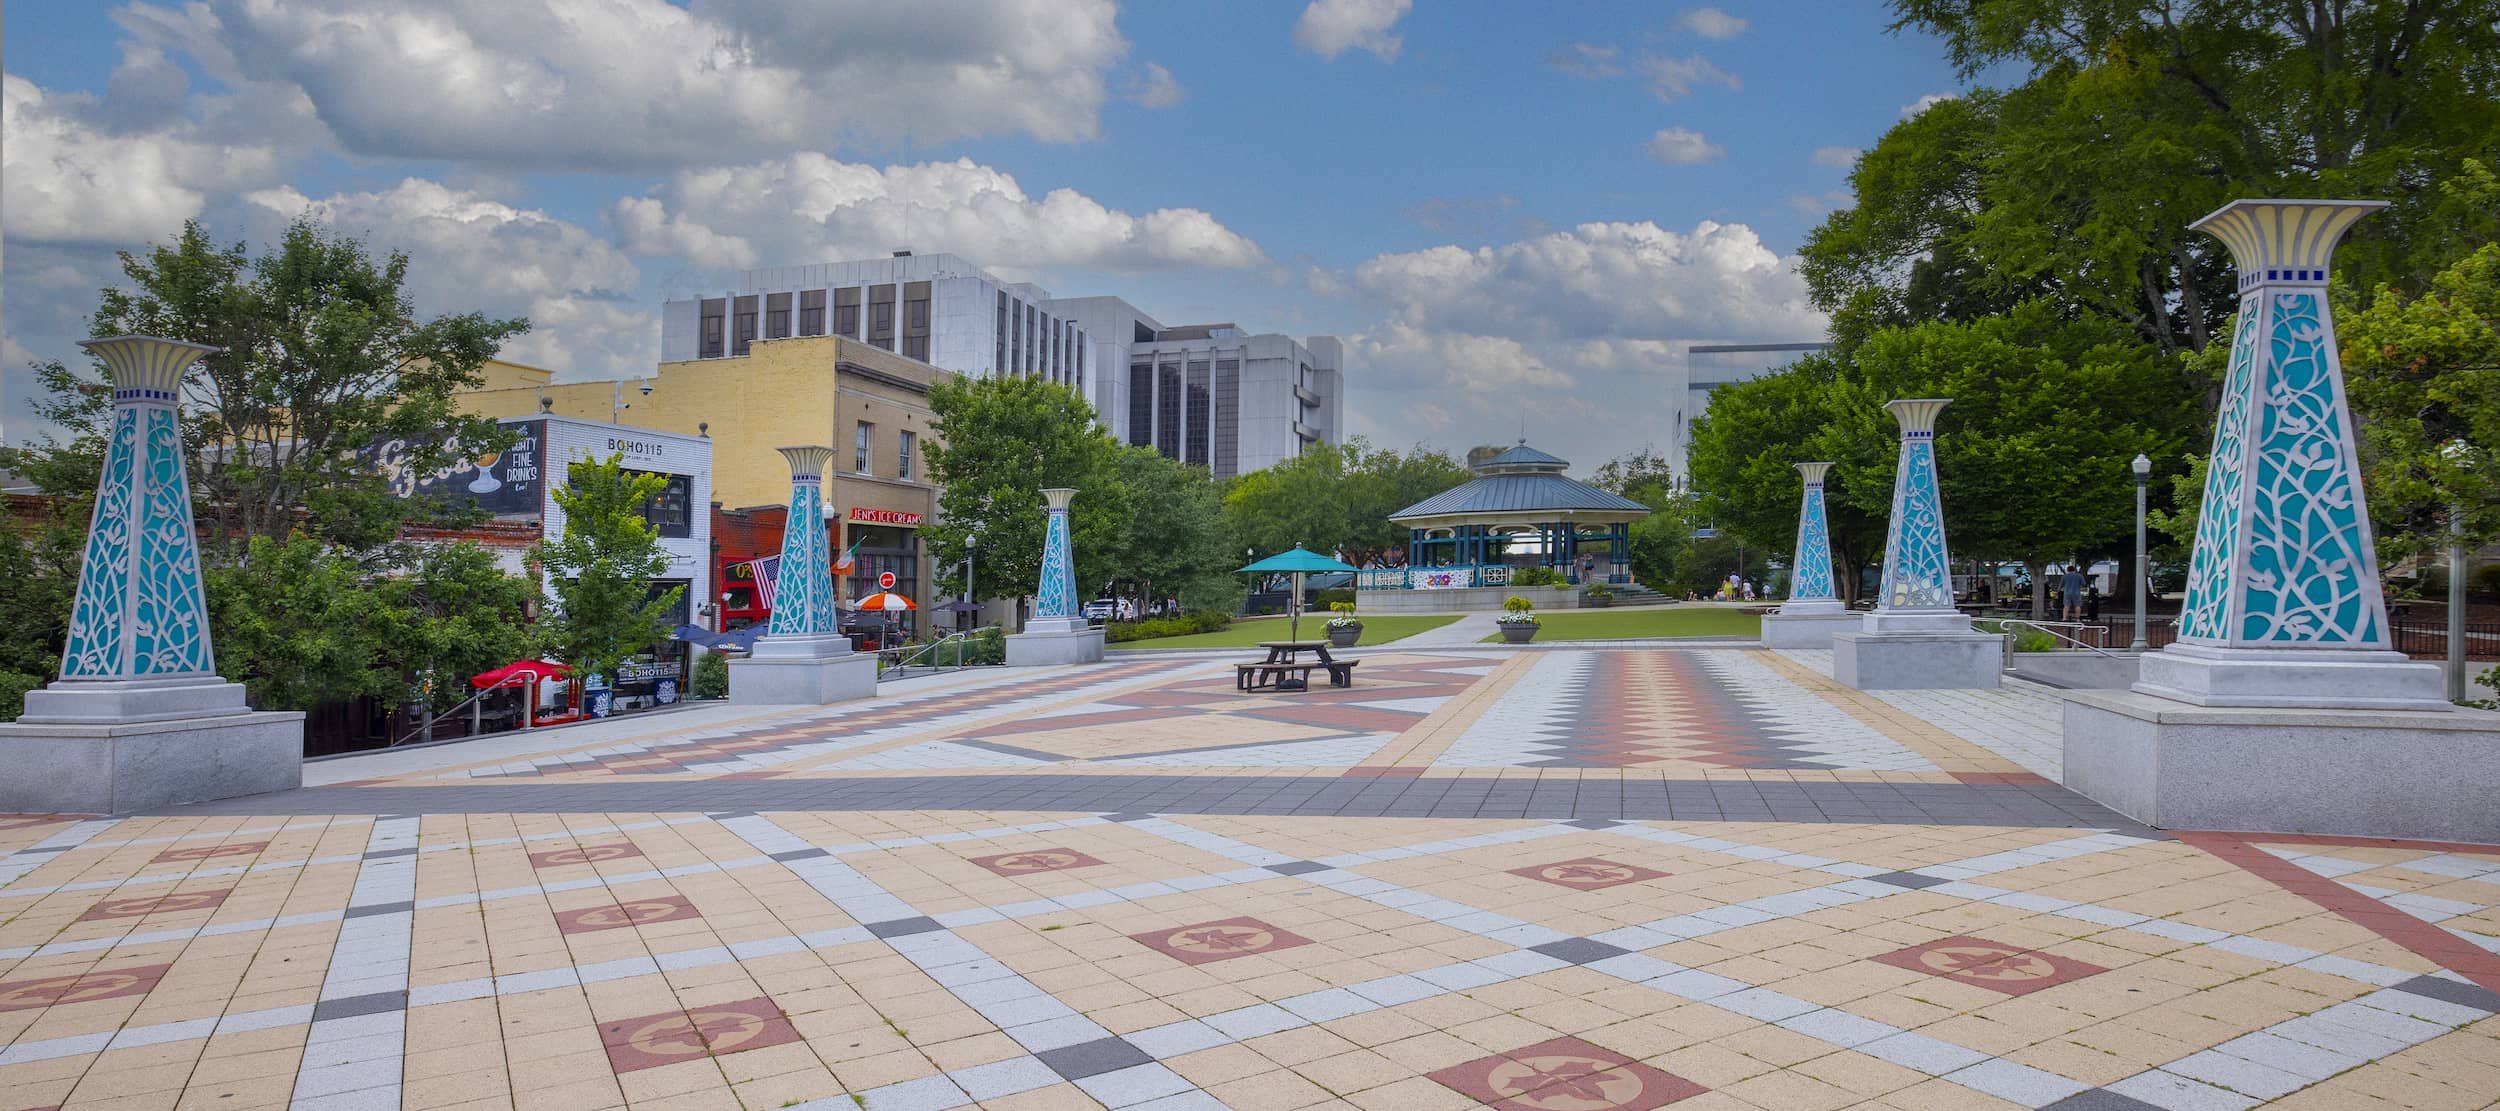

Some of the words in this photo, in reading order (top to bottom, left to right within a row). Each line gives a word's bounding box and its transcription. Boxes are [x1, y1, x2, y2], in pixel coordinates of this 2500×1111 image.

[608, 437, 662, 456] BOHO115
[512, 452, 532, 467] FINE
[506, 467, 537, 482] DRINKS
[854, 508, 876, 520] JENI'S
[878, 511, 891, 522] ICE
[892, 512, 922, 524] CREAMS
